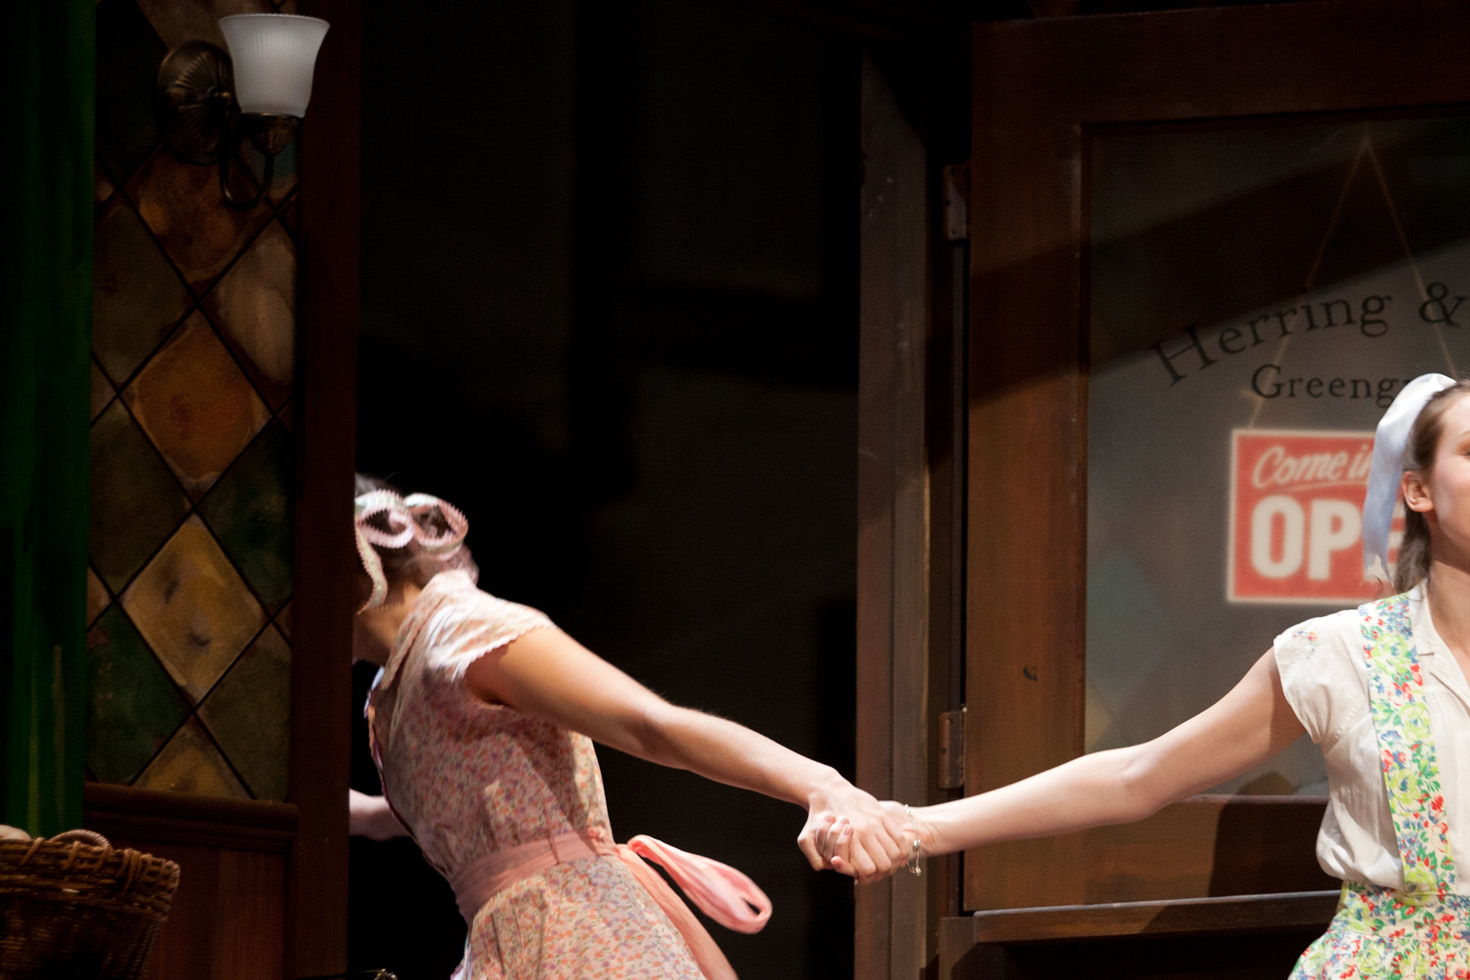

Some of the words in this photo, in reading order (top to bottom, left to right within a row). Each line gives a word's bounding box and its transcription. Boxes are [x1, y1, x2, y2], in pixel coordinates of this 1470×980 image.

[1151, 295, 1393, 387] Herring
[1419, 282, 1467, 328] &
[1251, 364, 1410, 409] Greeng
[1252, 445, 1348, 489] Come
